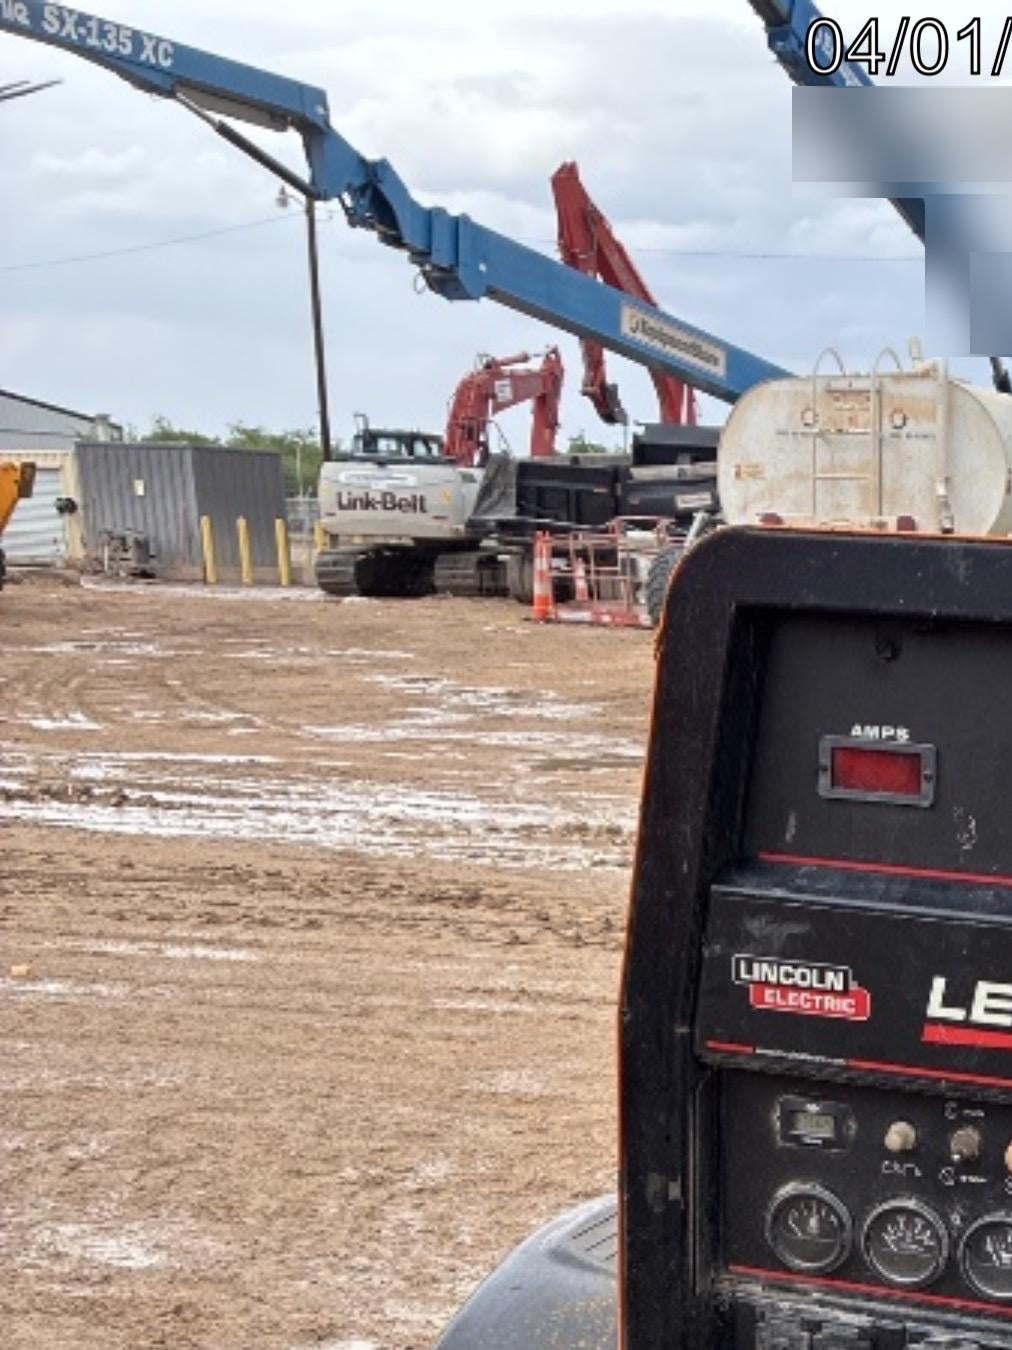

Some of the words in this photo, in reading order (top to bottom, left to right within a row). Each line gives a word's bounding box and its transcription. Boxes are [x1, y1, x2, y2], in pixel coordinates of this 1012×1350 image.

[41, 4, 133, 55] SX-135
[140, 32, 175, 67] XC
[336, 490, 427, 514] Link-Belt
[850, 723, 911, 743] AMPS
[739, 962, 844, 992] LINCOLN
[763, 989, 857, 1014] ELECTRIC
